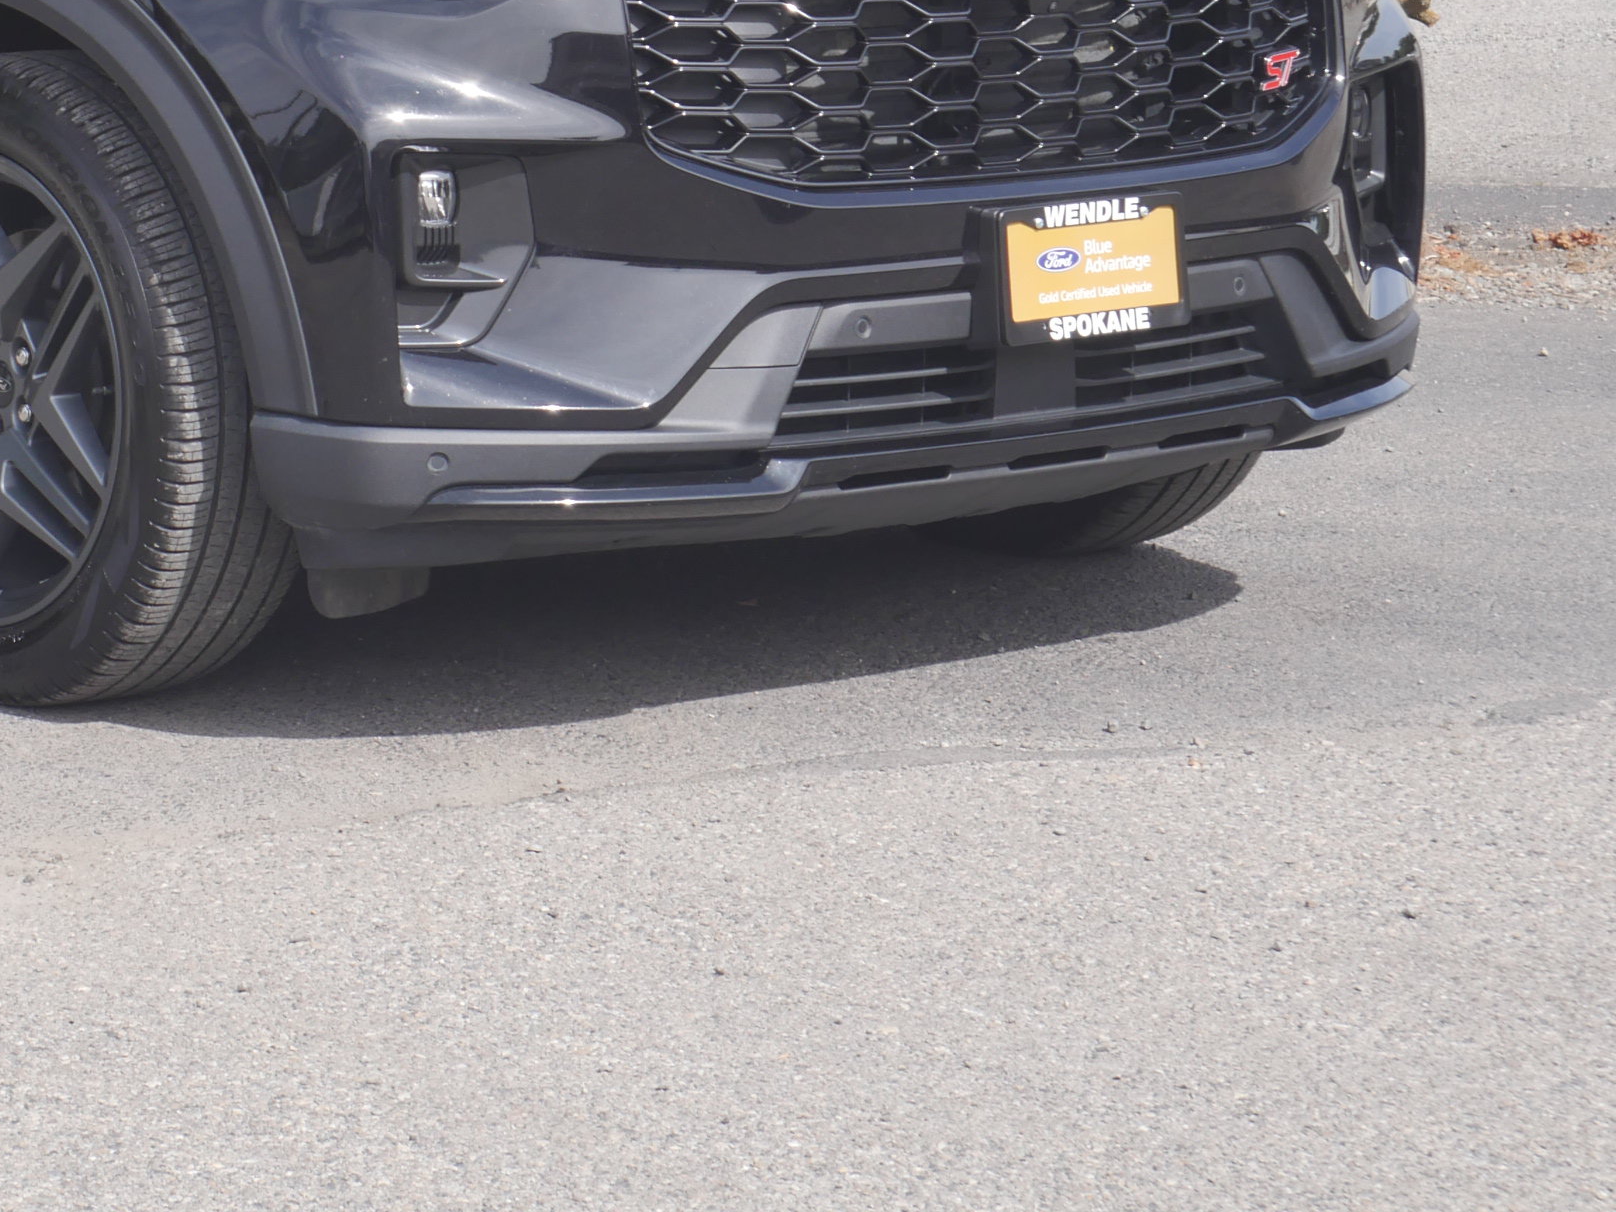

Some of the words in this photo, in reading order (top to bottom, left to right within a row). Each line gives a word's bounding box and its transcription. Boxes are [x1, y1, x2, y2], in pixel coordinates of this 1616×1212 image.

[1260, 49, 1300, 91] ST
[1044, 197, 1139, 228] WENDLE
[1084, 239, 1112, 255] Blue
[1045, 251, 1073, 268] Ford
[1085, 255, 1151, 273] Advantage
[1039, 291, 1060, 304] Gold
[1060, 287, 1097, 302] Certified
[1098, 285, 1121, 298] Used
[1123, 281, 1152, 295] Vehicle
[1049, 306, 1151, 340] SPOKANE
